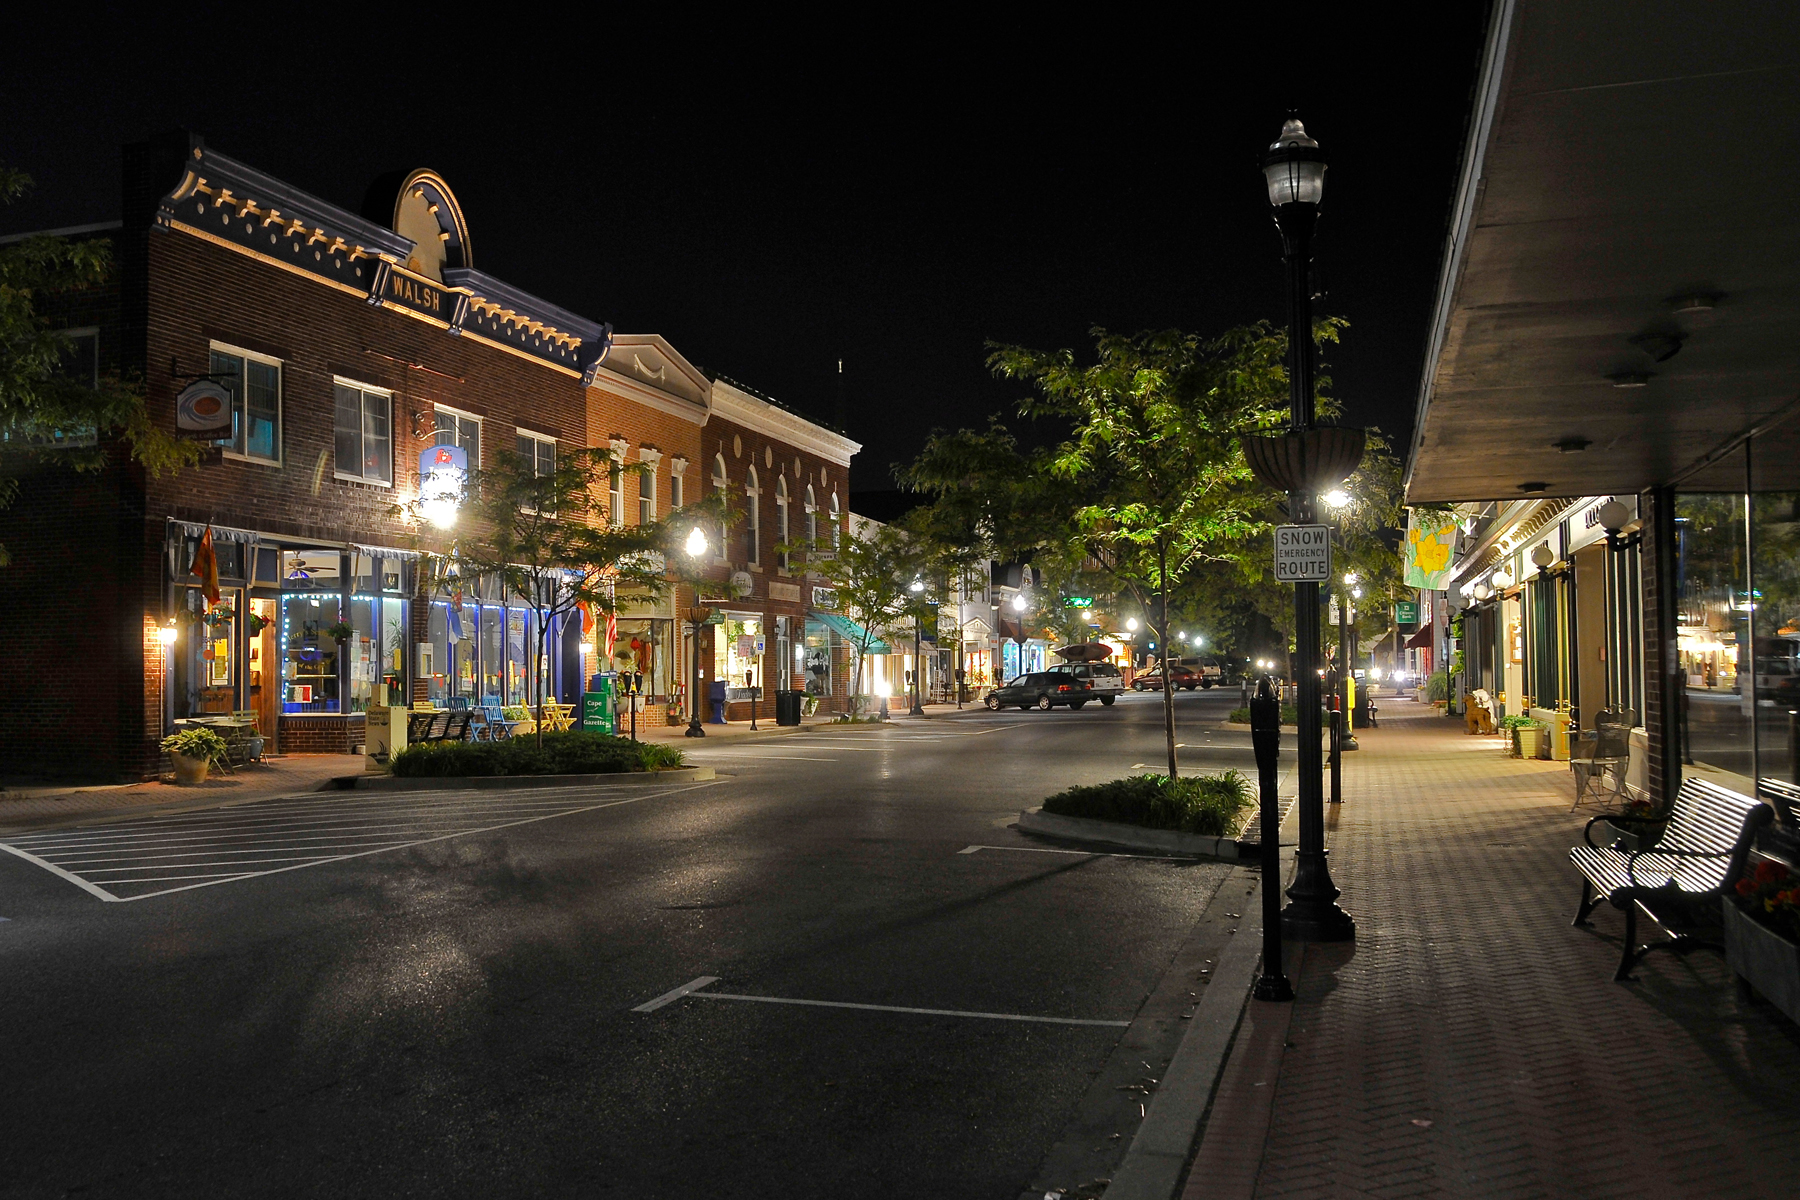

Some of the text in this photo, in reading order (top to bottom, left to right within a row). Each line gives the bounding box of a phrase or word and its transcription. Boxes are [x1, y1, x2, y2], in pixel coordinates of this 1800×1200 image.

[393, 275, 440, 311] WALSH
[1281, 531, 1324, 545] SNOW
[1279, 548, 1325, 558] EMERGENCY
[1279, 561, 1326, 575] ROUTE
